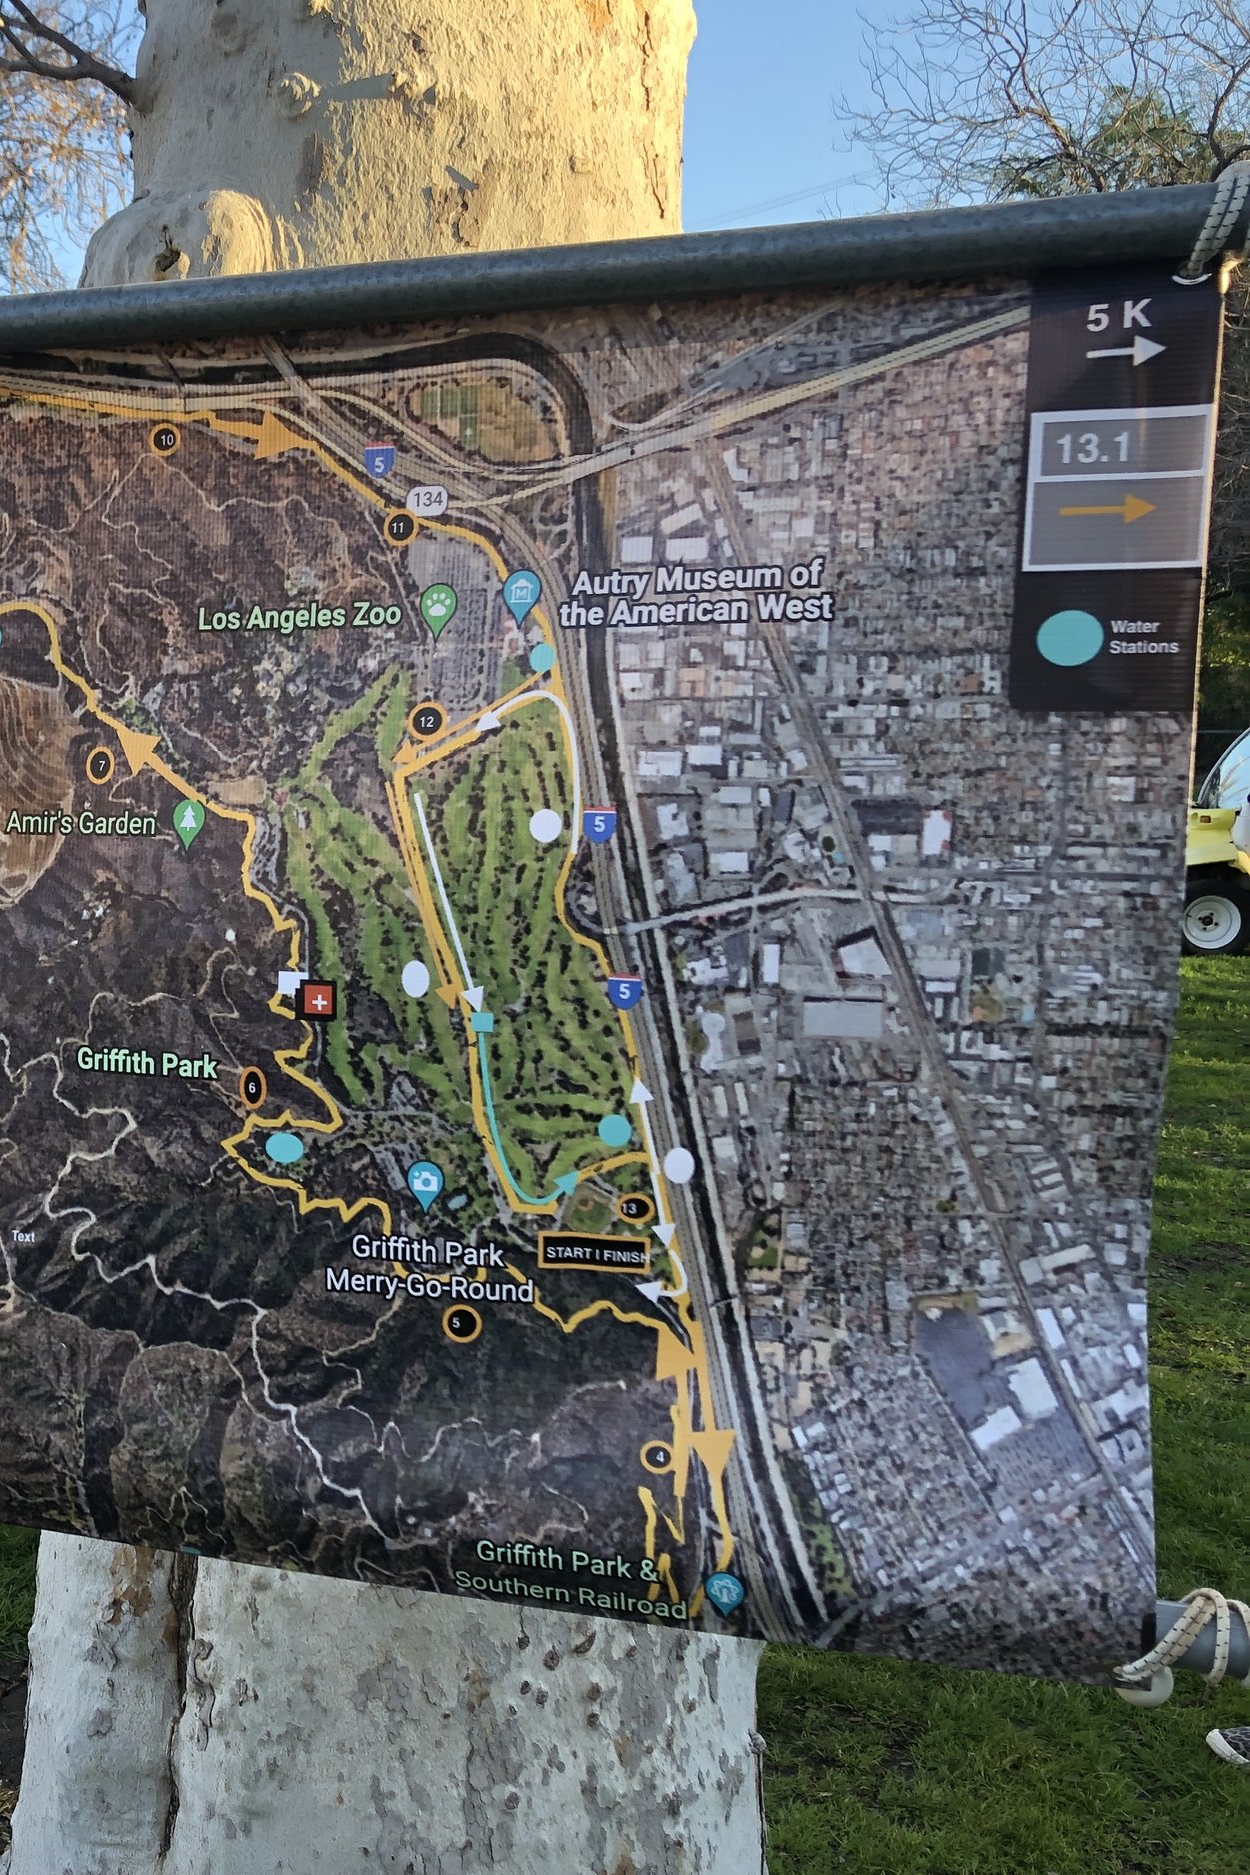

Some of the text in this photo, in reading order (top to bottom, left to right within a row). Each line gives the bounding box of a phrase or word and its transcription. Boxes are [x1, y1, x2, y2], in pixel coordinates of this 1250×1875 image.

[1088, 298, 1152, 332] 5 K
[160, 433, 174, 446] 10
[1057, 432, 1130, 464] 13.1
[375, 457, 385, 473] 5
[414, 491, 444, 508] 134
[392, 521, 405, 534] 11
[573, 558, 824, 601] Autry Museum of
[560, 594, 833, 626] the American West
[199, 603, 402, 635] Los Angeles Zoo
[1111, 620, 1160, 634] Water
[1109, 640, 1179, 655] Stations
[420, 716, 434, 728] 12
[99, 761, 105, 771] 7
[7, 811, 155, 835] Amir's Garden
[594, 817, 605, 832] 5
[619, 984, 630, 999] 5
[78, 1046, 218, 1079] Griffith Park
[249, 1082, 256, 1093] 6
[622, 1203, 637, 1214] 13
[12, 1230, 35, 1243] Text
[352, 1233, 504, 1268] Griffith Park
[546, 1246, 592, 1259] START
[604, 1250, 650, 1263] FINISH
[326, 1267, 534, 1302] Merry-Go-Round
[453, 1317, 460, 1329] 5
[656, 1451, 664, 1462] 4
[477, 1540, 659, 1581] Griffith Park &
[455, 1571, 687, 1620] Southern Railroad
